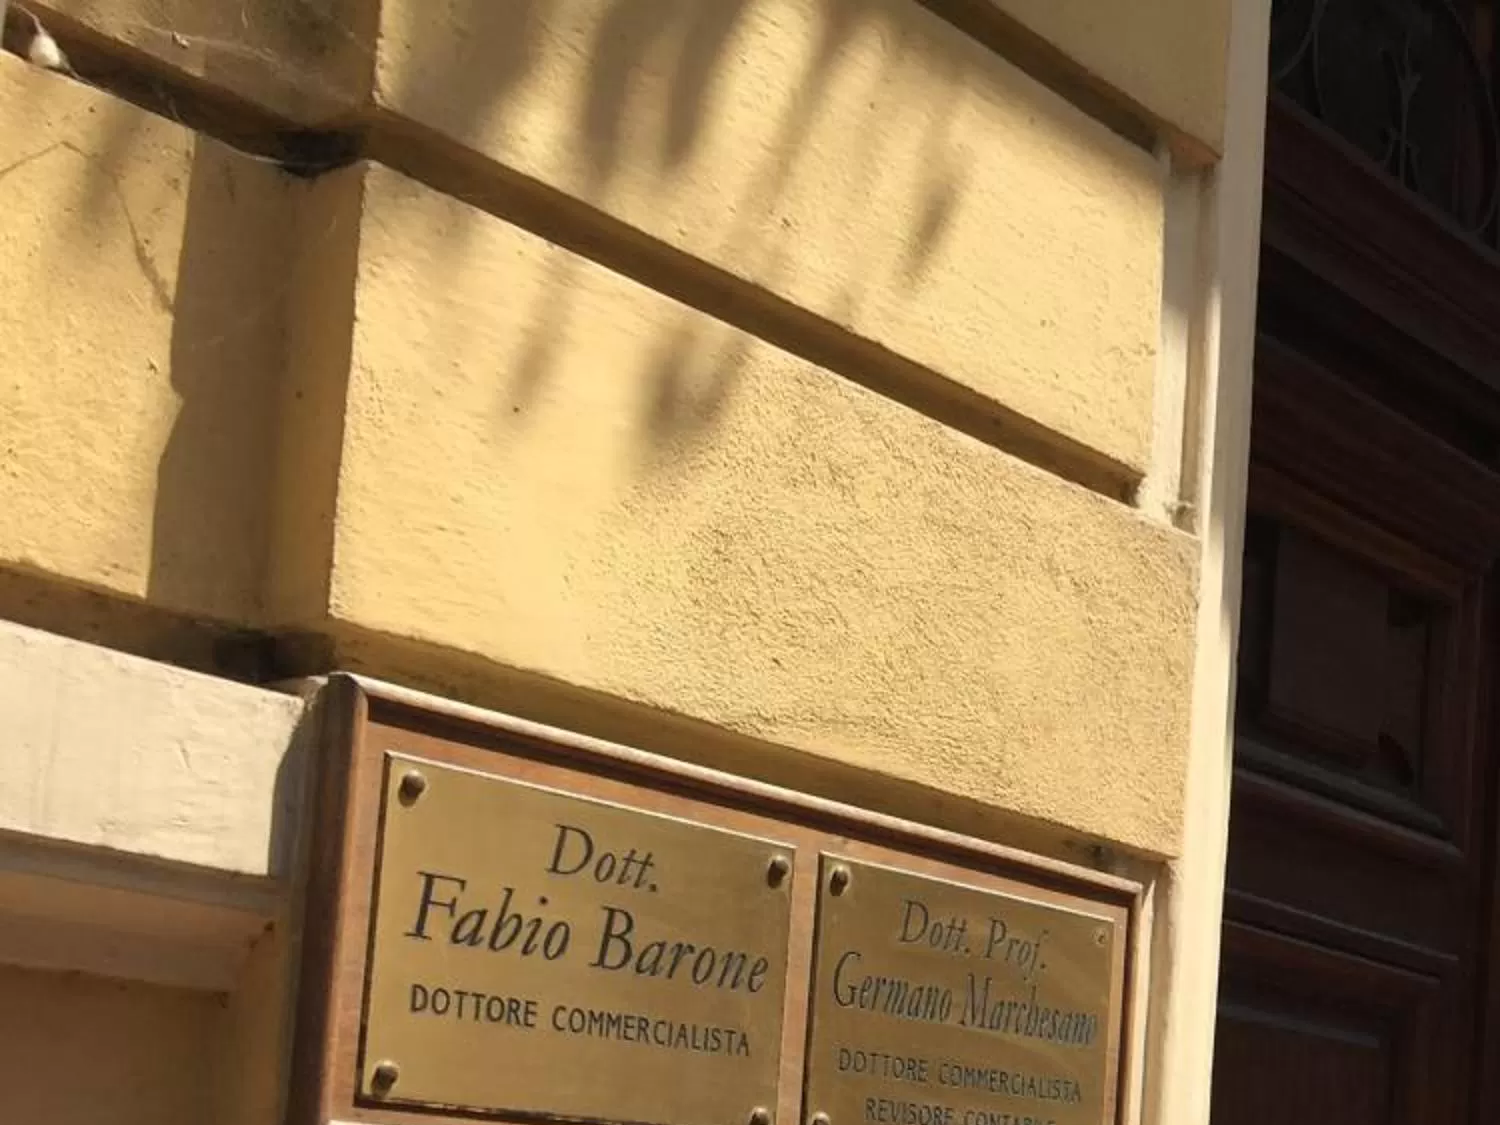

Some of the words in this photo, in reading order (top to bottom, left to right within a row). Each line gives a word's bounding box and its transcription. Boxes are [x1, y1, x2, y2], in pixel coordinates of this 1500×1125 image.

[545, 824, 658, 892] Dott.
[404, 870, 571, 961] Fabio
[589, 904, 769, 993] Barone
[900, 900, 970, 953] Dott.
[983, 916, 1048, 980] Prof.
[410, 983, 539, 1029] DOTTORE
[552, 1005, 750, 1057] COMMERCIALISTA
[833, 951, 952, 1025] Germano
[958, 972, 1098, 1045] Marchesano
[838, 1048, 929, 1083] DOTTORE
[939, 1063, 1081, 1103] COMMERCIALISTA
